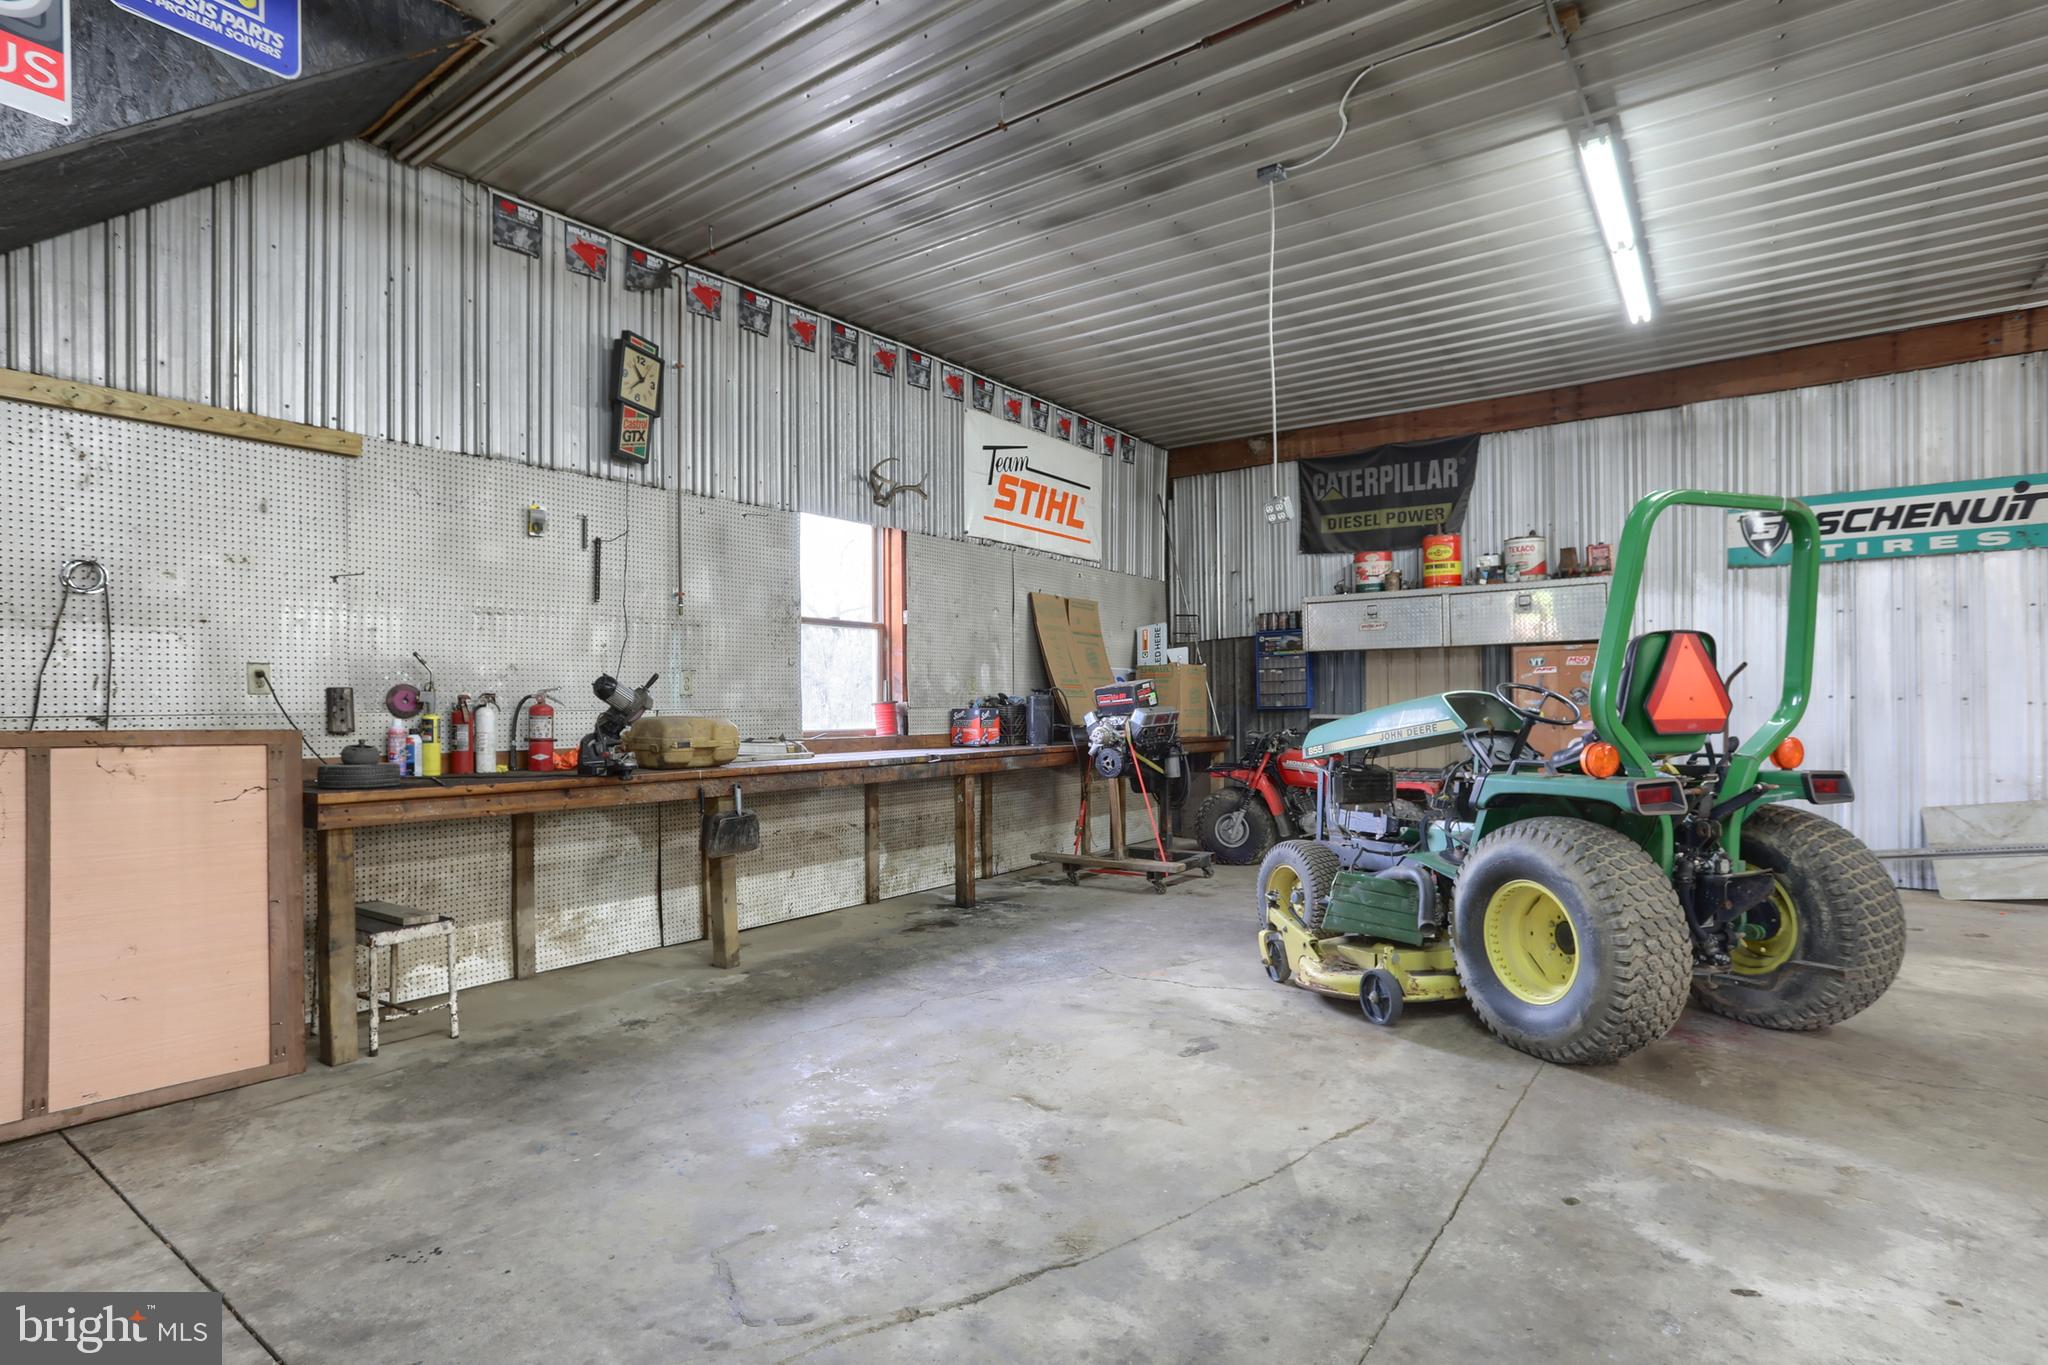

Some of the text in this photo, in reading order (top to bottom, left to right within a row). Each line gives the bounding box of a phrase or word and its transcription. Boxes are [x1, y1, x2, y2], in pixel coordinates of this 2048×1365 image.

[155, 0, 282, 59] PROBLEM SOLVERS
[221, 9, 285, 49] PARTS
[637, 355, 646, 367] 12
[622, 430, 646, 443] GTX
[1312, 457, 1459, 500] CATERPILLAR
[993, 473, 1085, 530] STIHL
[1327, 507, 1445, 531] DIESEL POWER
[1507, 544, 1536, 554] TEXACO
[1821, 530, 2012, 558] TIRES
[1154, 627, 1162, 648] HERE
[1379, 723, 1438, 742] JOHN DEERE
